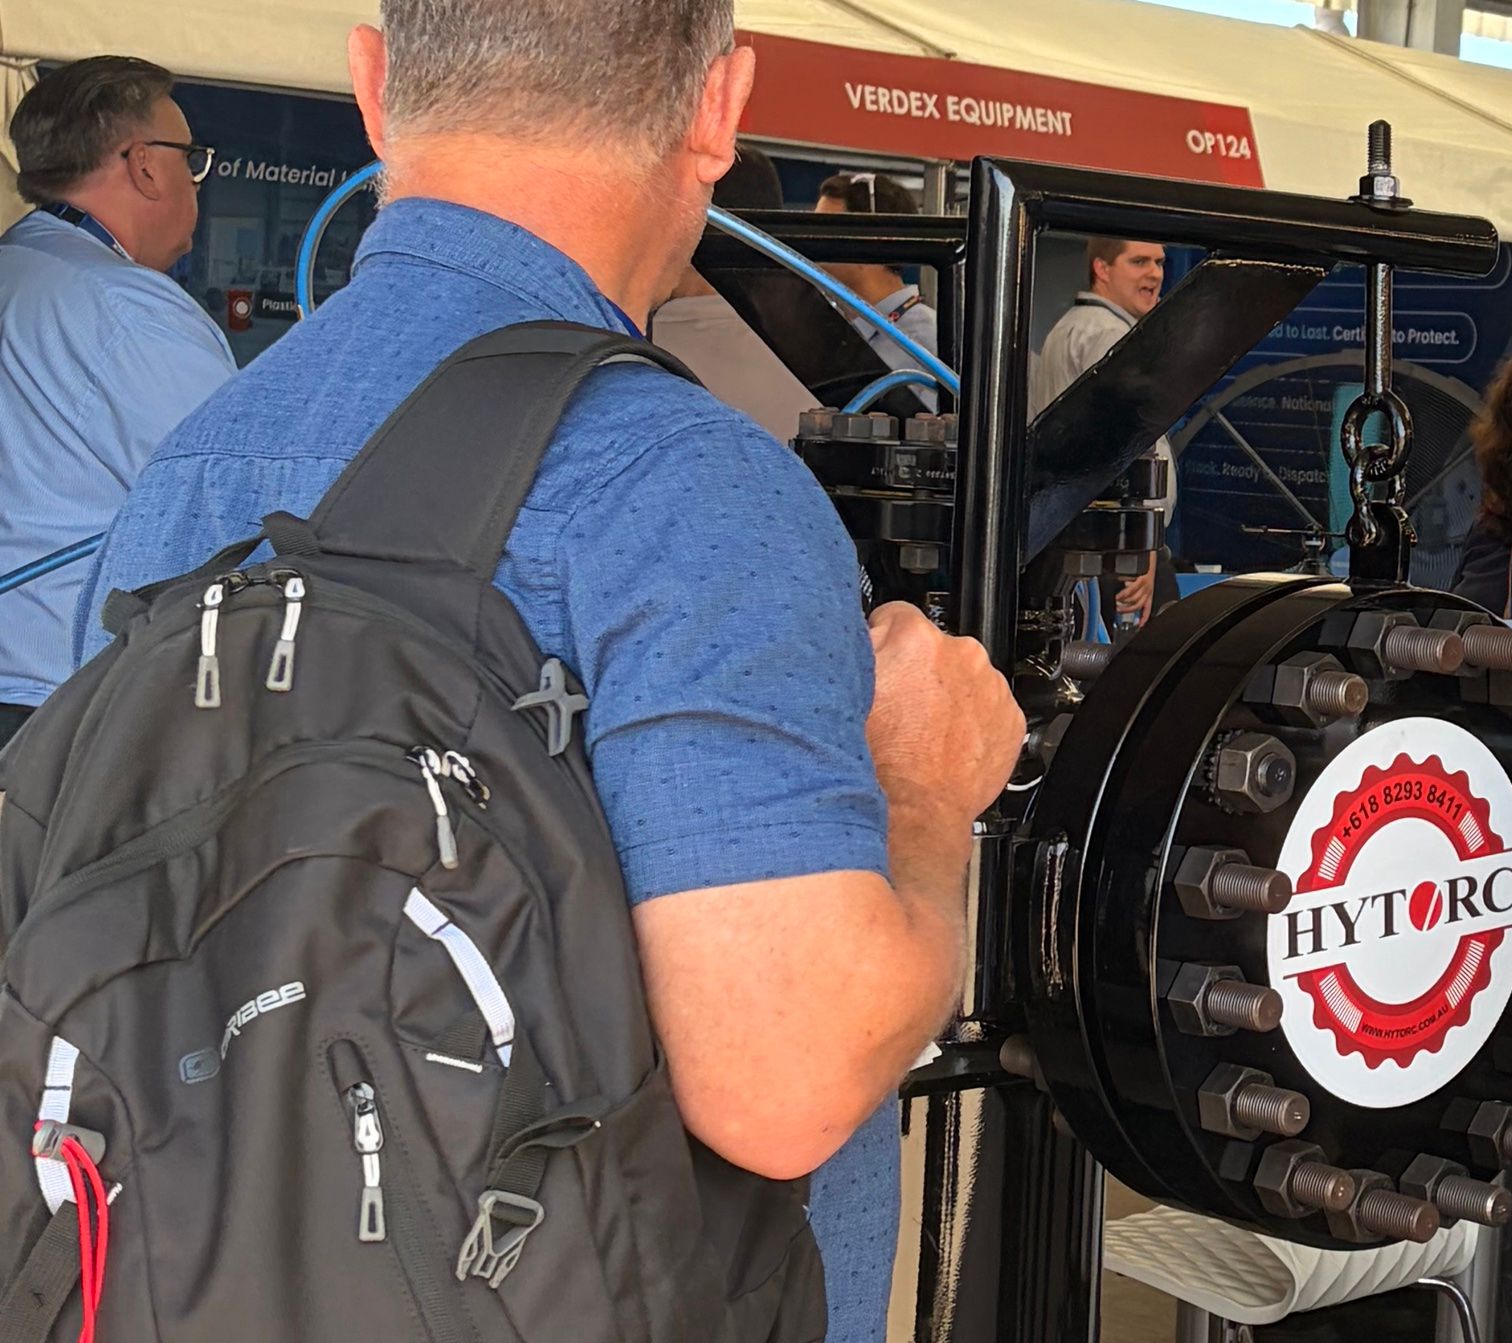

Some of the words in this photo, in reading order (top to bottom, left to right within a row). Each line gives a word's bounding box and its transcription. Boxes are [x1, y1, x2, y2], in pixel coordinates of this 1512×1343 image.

[843, 81, 941, 120] VERDEX
[946, 94, 1072, 136] EQUIPMENT
[1186, 129, 1251, 160] OP124
[217, 158, 242, 177] of
[245, 159, 335, 187] Material
[1286, 324, 1299, 337] to
[1332, 325, 1366, 341] Certi
[1407, 328, 1460, 344] Protect.
[1278, 465, 1330, 485] Dispatc
[1340, 794, 1381, 840] +618
[1382, 780, 1424, 805] 8293
[1426, 784, 1464, 822] 8411
[1360, 1004, 1450, 1040] WWW.HYTORC.COM.AU
